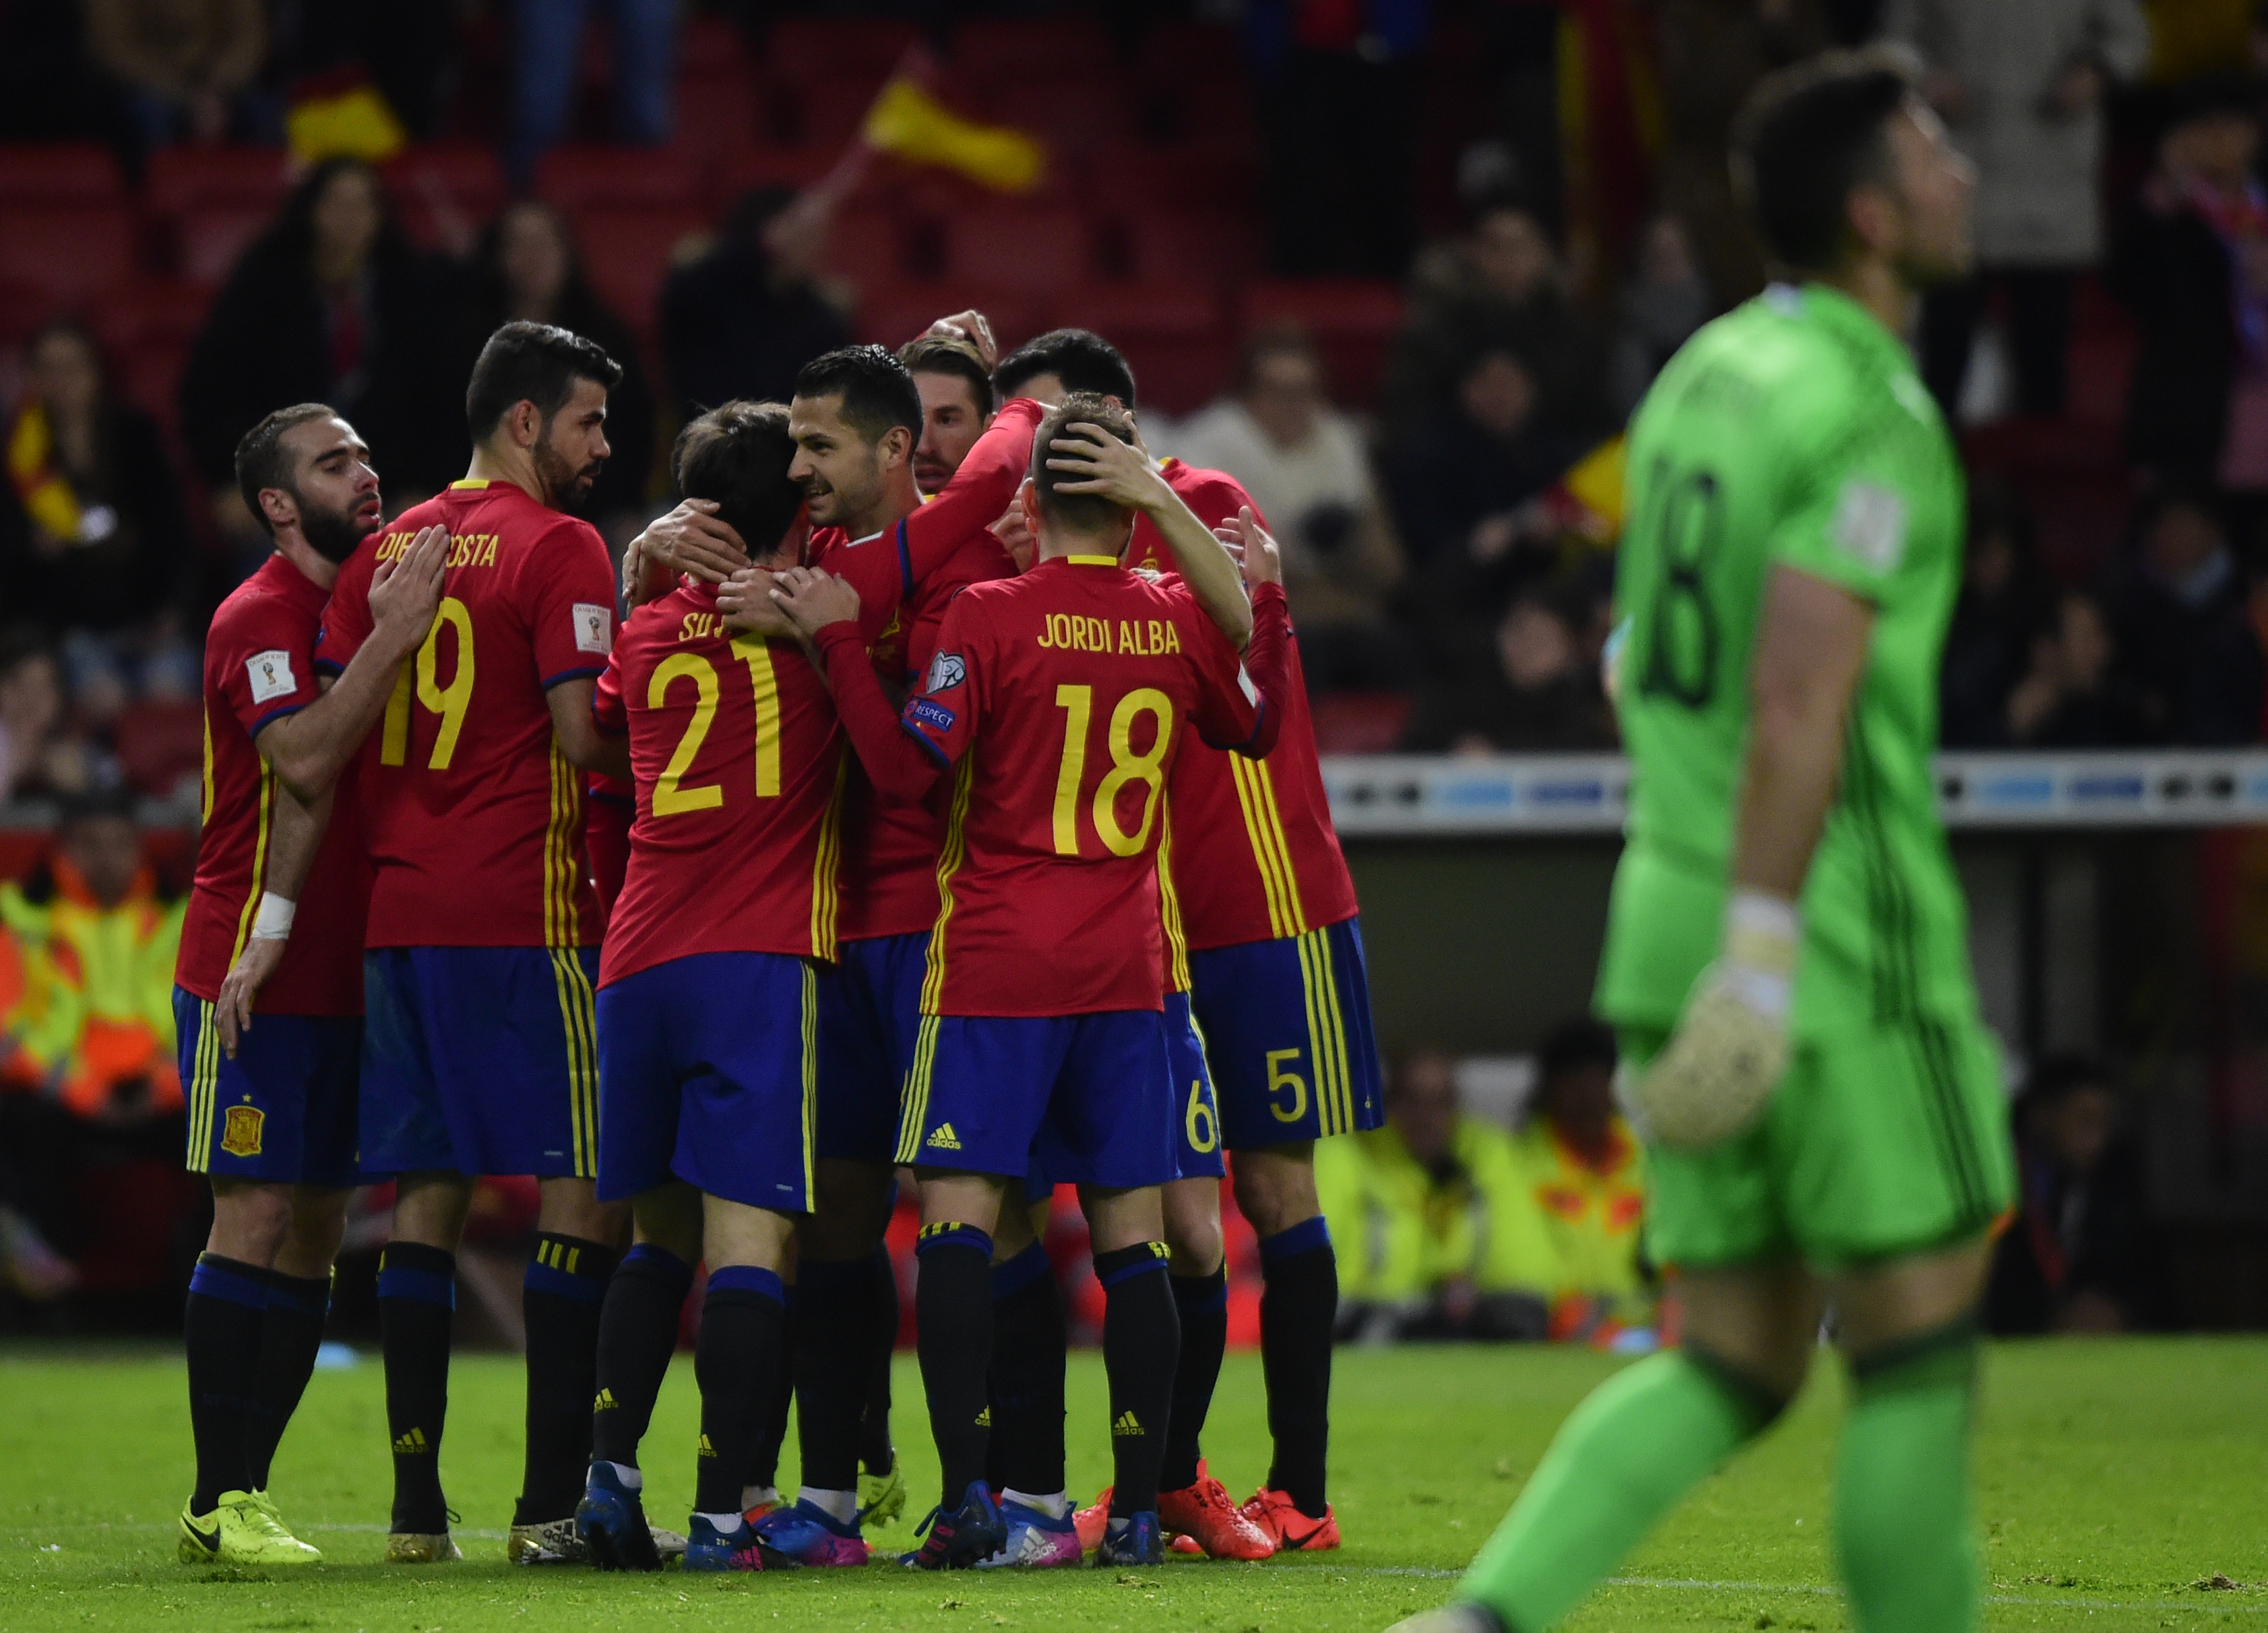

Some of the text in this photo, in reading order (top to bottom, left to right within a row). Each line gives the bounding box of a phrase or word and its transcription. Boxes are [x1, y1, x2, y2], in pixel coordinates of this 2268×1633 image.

[375, 532, 499, 568] DIE OSTA
[1037, 614, 1180, 655] JORDI ALBA
[648, 631, 781, 818] 21
[915, 705, 953, 727] RESPECT
[1053, 684, 1172, 857] 18
[1186, 1080, 1215, 1153] 6
[1266, 1048, 1308, 1122] 5
